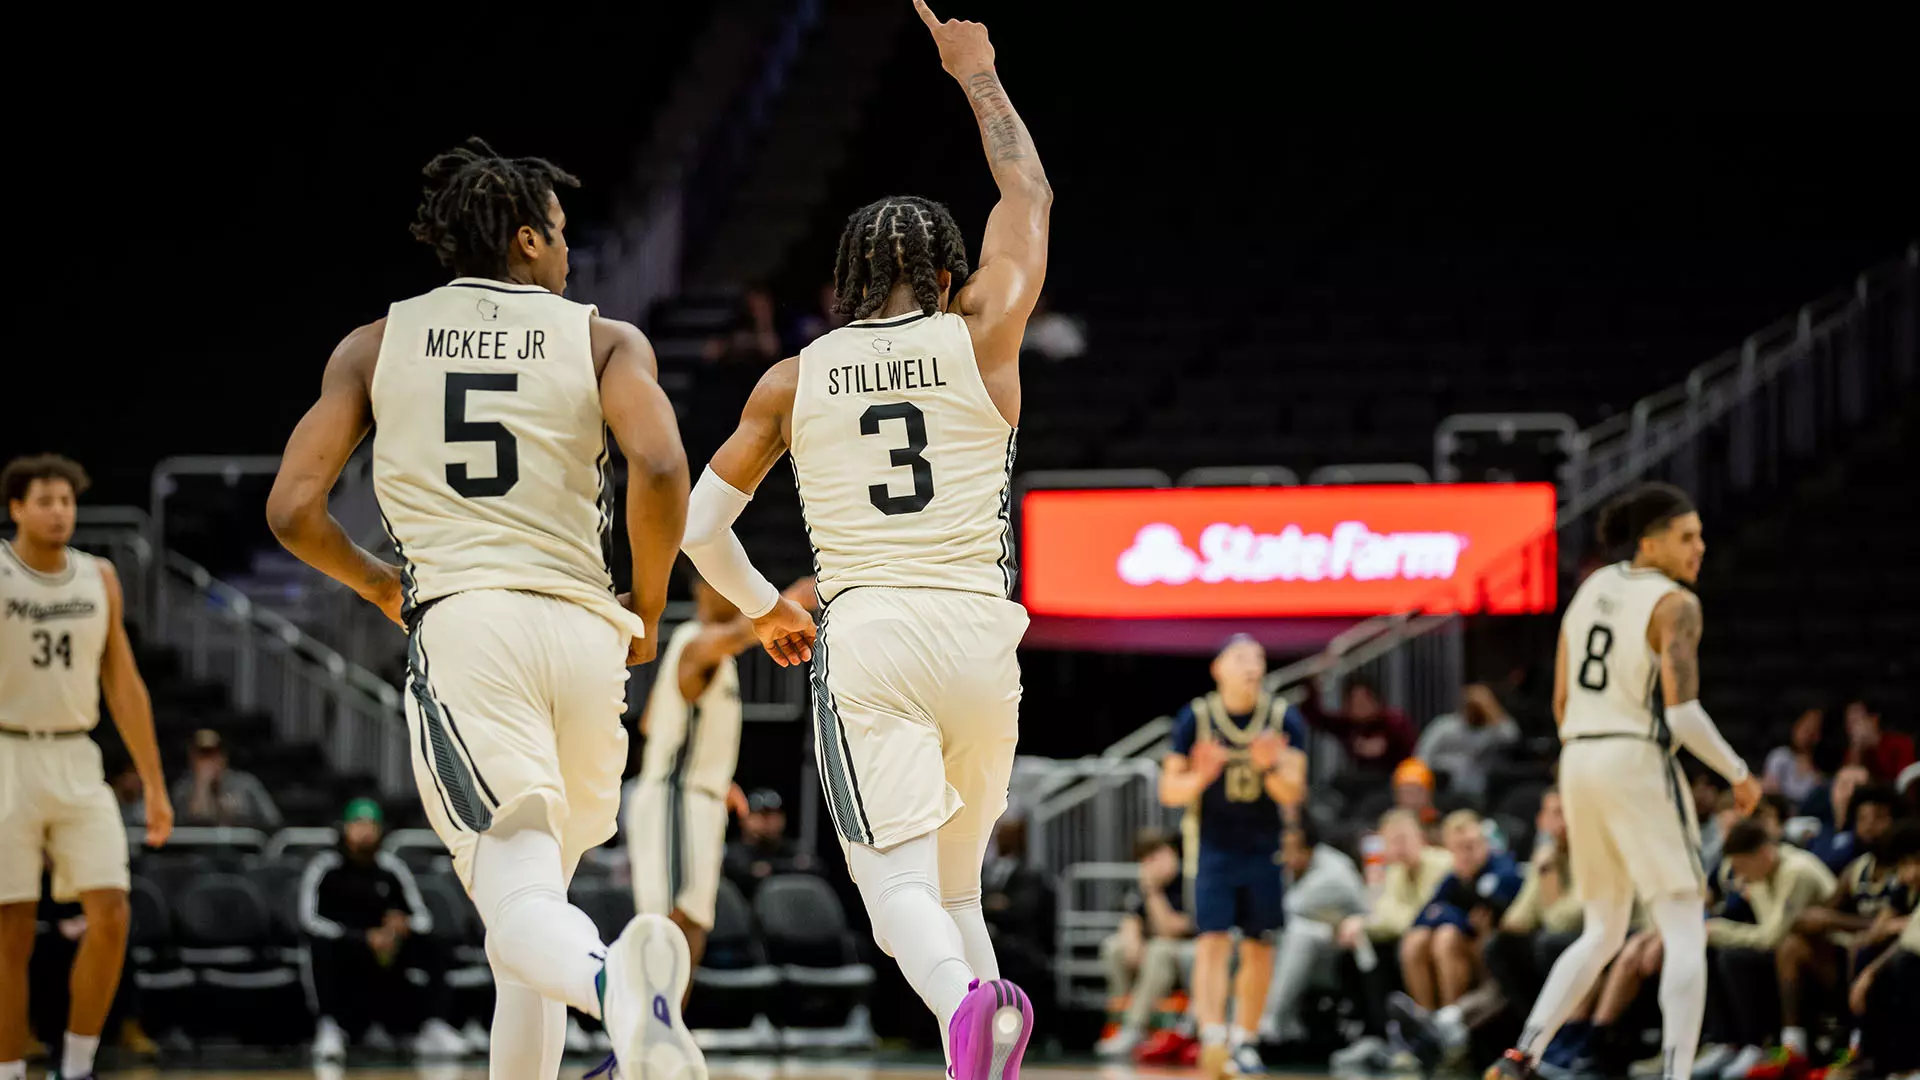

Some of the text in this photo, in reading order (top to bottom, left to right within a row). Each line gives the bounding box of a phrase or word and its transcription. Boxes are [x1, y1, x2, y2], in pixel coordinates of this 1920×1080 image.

[425, 328, 545, 360] MCKEE JR
[828, 357, 947, 396] STILLWELL
[445, 372, 519, 499] 5
[859, 402, 935, 516] 3
[1201, 521, 1461, 582] State Farm
[31, 630, 73, 670] 34
[1579, 624, 1613, 691] 8
